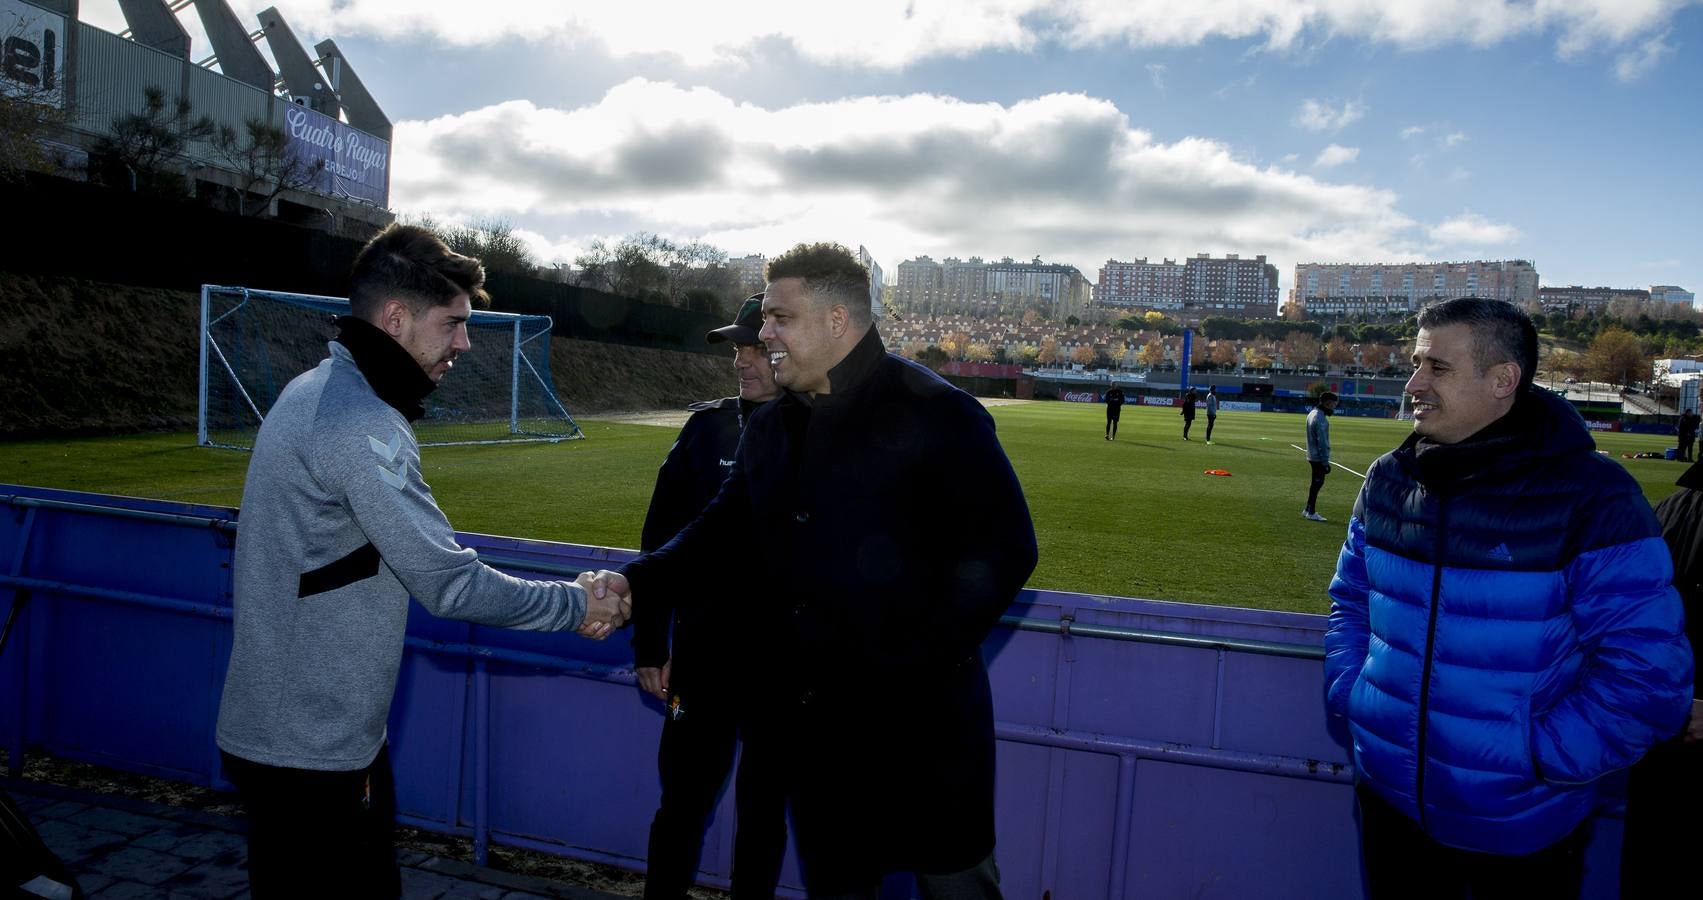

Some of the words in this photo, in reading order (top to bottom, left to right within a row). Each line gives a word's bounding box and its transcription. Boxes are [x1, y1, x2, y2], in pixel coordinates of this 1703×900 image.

[0, 28, 56, 91] el
[287, 108, 344, 153] Cuatro
[346, 132, 386, 170] Rayas
[320, 158, 358, 181] ERDEJO
